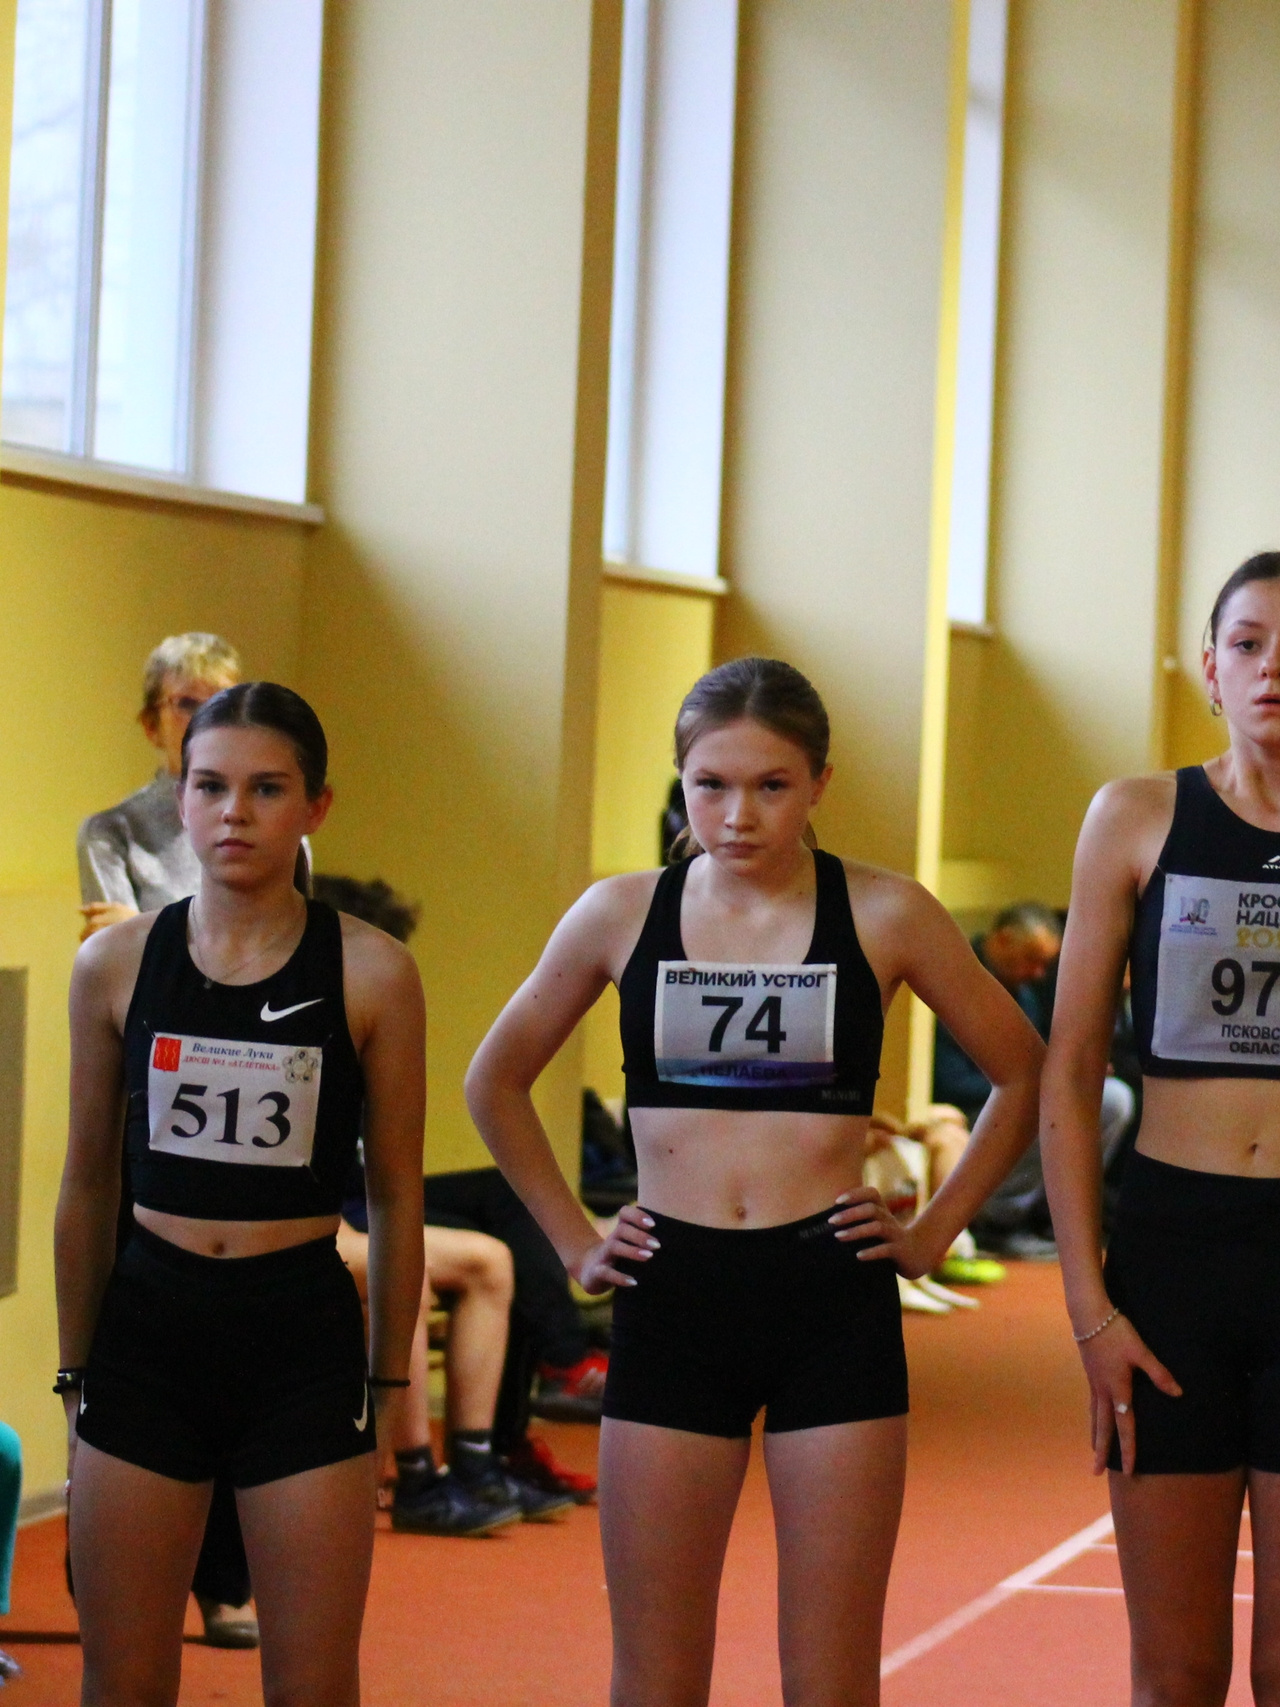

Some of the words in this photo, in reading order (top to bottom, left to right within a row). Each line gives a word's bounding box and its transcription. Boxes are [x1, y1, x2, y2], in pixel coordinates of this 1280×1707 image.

[665, 969, 756, 988] ВЕЛИКИЙ
[762, 972, 828, 989] УСТЮГ
[701, 995, 787, 1054] 74
[192, 1043, 242, 1057] Великие
[243, 1048, 274, 1060] Луки
[170, 1082, 291, 1148] 513
